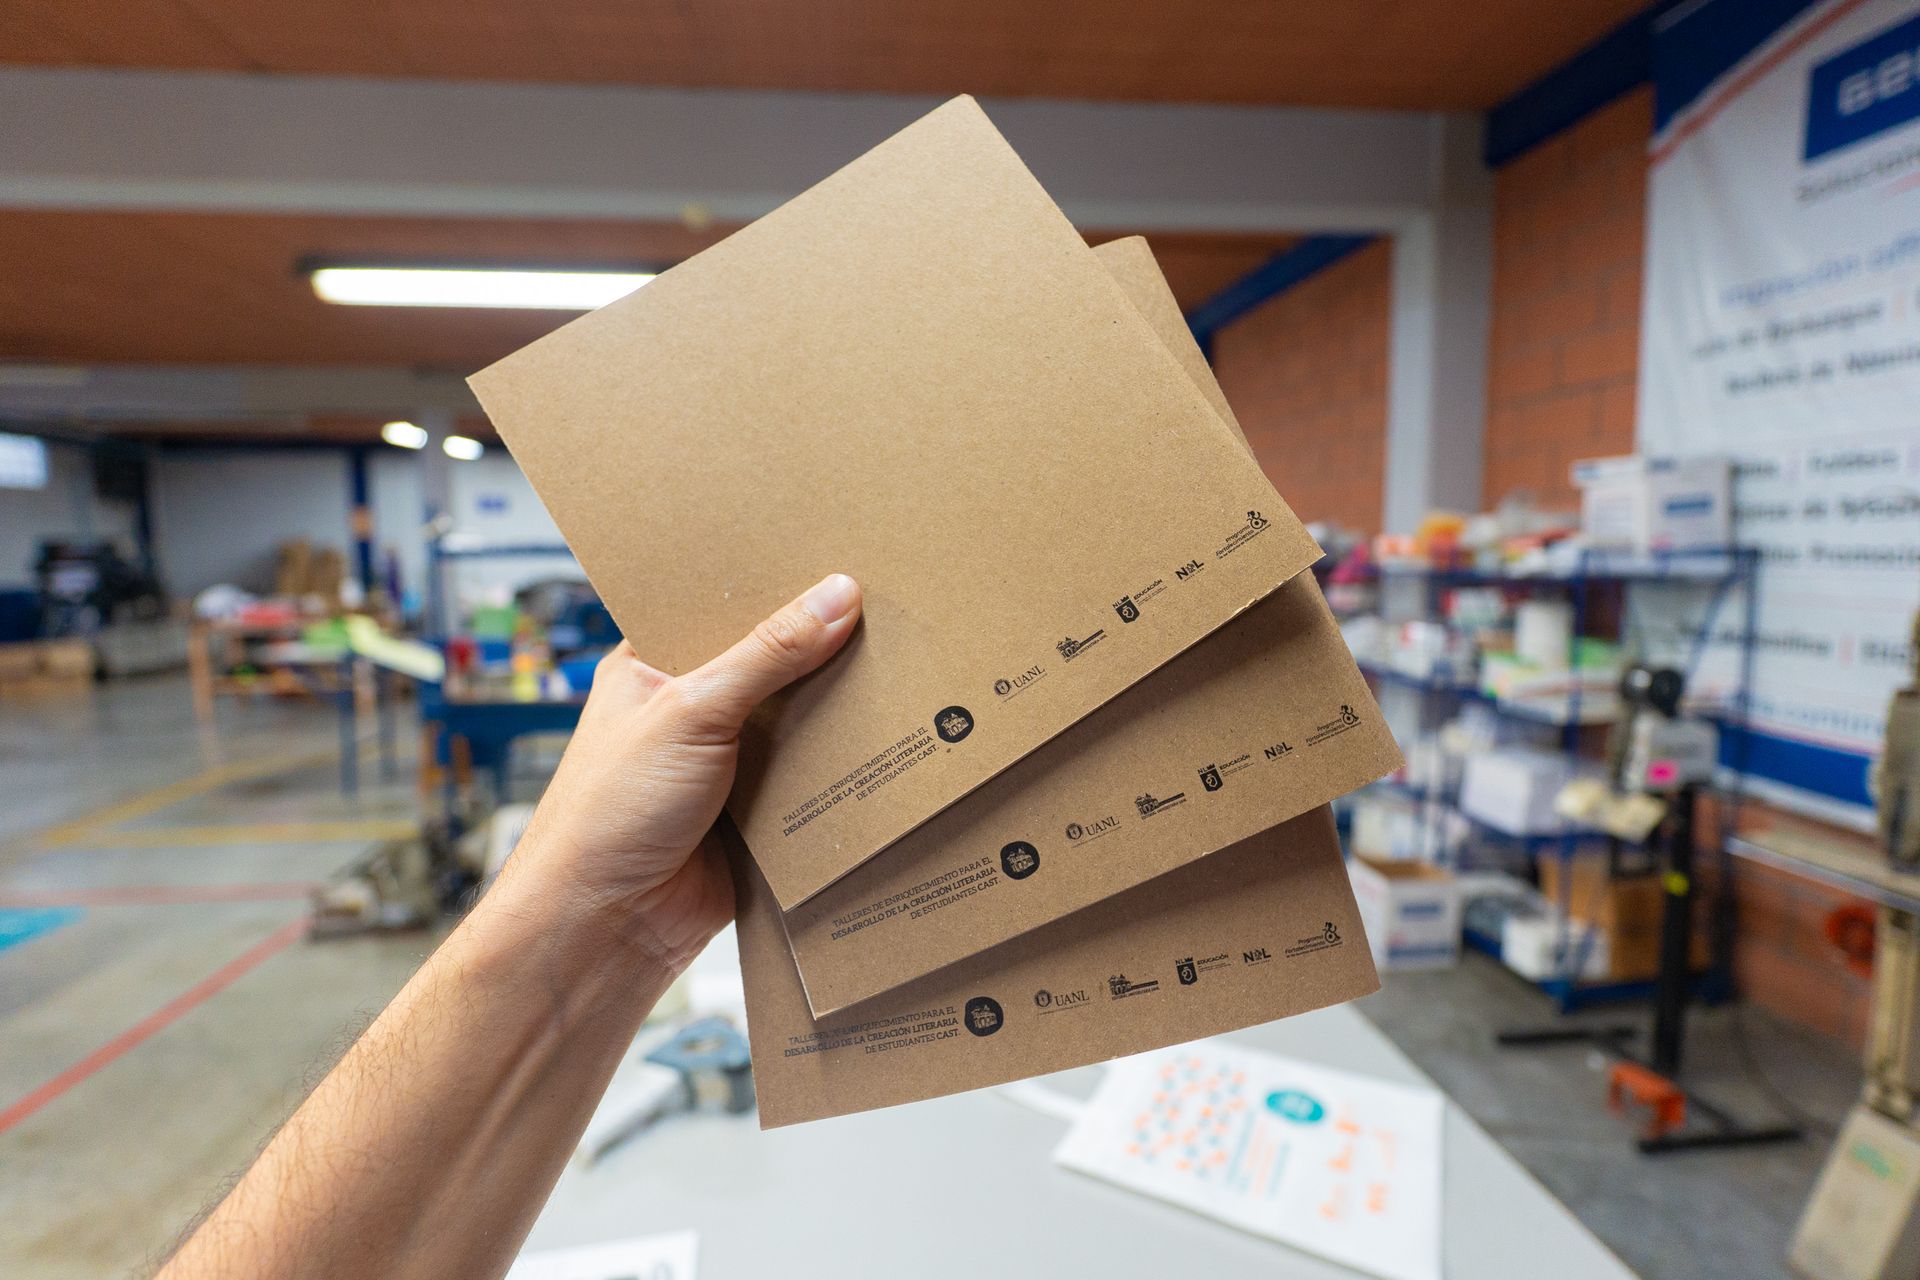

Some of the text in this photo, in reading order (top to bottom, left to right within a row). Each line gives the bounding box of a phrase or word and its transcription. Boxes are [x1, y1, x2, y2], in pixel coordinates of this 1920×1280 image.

[1133, 578, 1163, 601] EDUCACIÓN
[1012, 665, 1046, 688] UANL
[856, 744, 940, 801] DE ESTUDIANTES CAST.
[1219, 753, 1251, 770] EDUCACIÓN
[783, 726, 928, 824] TALLERES DE ENRIQUECIMIENTO PARA EL
[783, 735, 933, 836] DESARROLLO DE LA CREACIÓN LITERARIA
[1085, 816, 1119, 836] UANL
[832, 867, 996, 940] DESARROLLO DE LA CREACIÓN LITERARIA
[834, 857, 992, 927] TALLERES DE ENRIQUECIMIENTO PARA EL
[911, 877, 1001, 919] DE ESTUDIANTES CAST.
[1197, 953, 1229, 965] EDUCACIÓN
[1055, 990, 1090, 1007] UANL
[922, 1009, 945, 1019] PARA
[785, 1042, 839, 1058] DESARROLLO
[841, 1039, 852, 1047] DE
[867, 1027, 911, 1042] CREACIÓN
[913, 1018, 958, 1033] LITERARIA
[866, 1046, 877, 1054] DE
[879, 1034, 935, 1051] ESTUDIANTES
